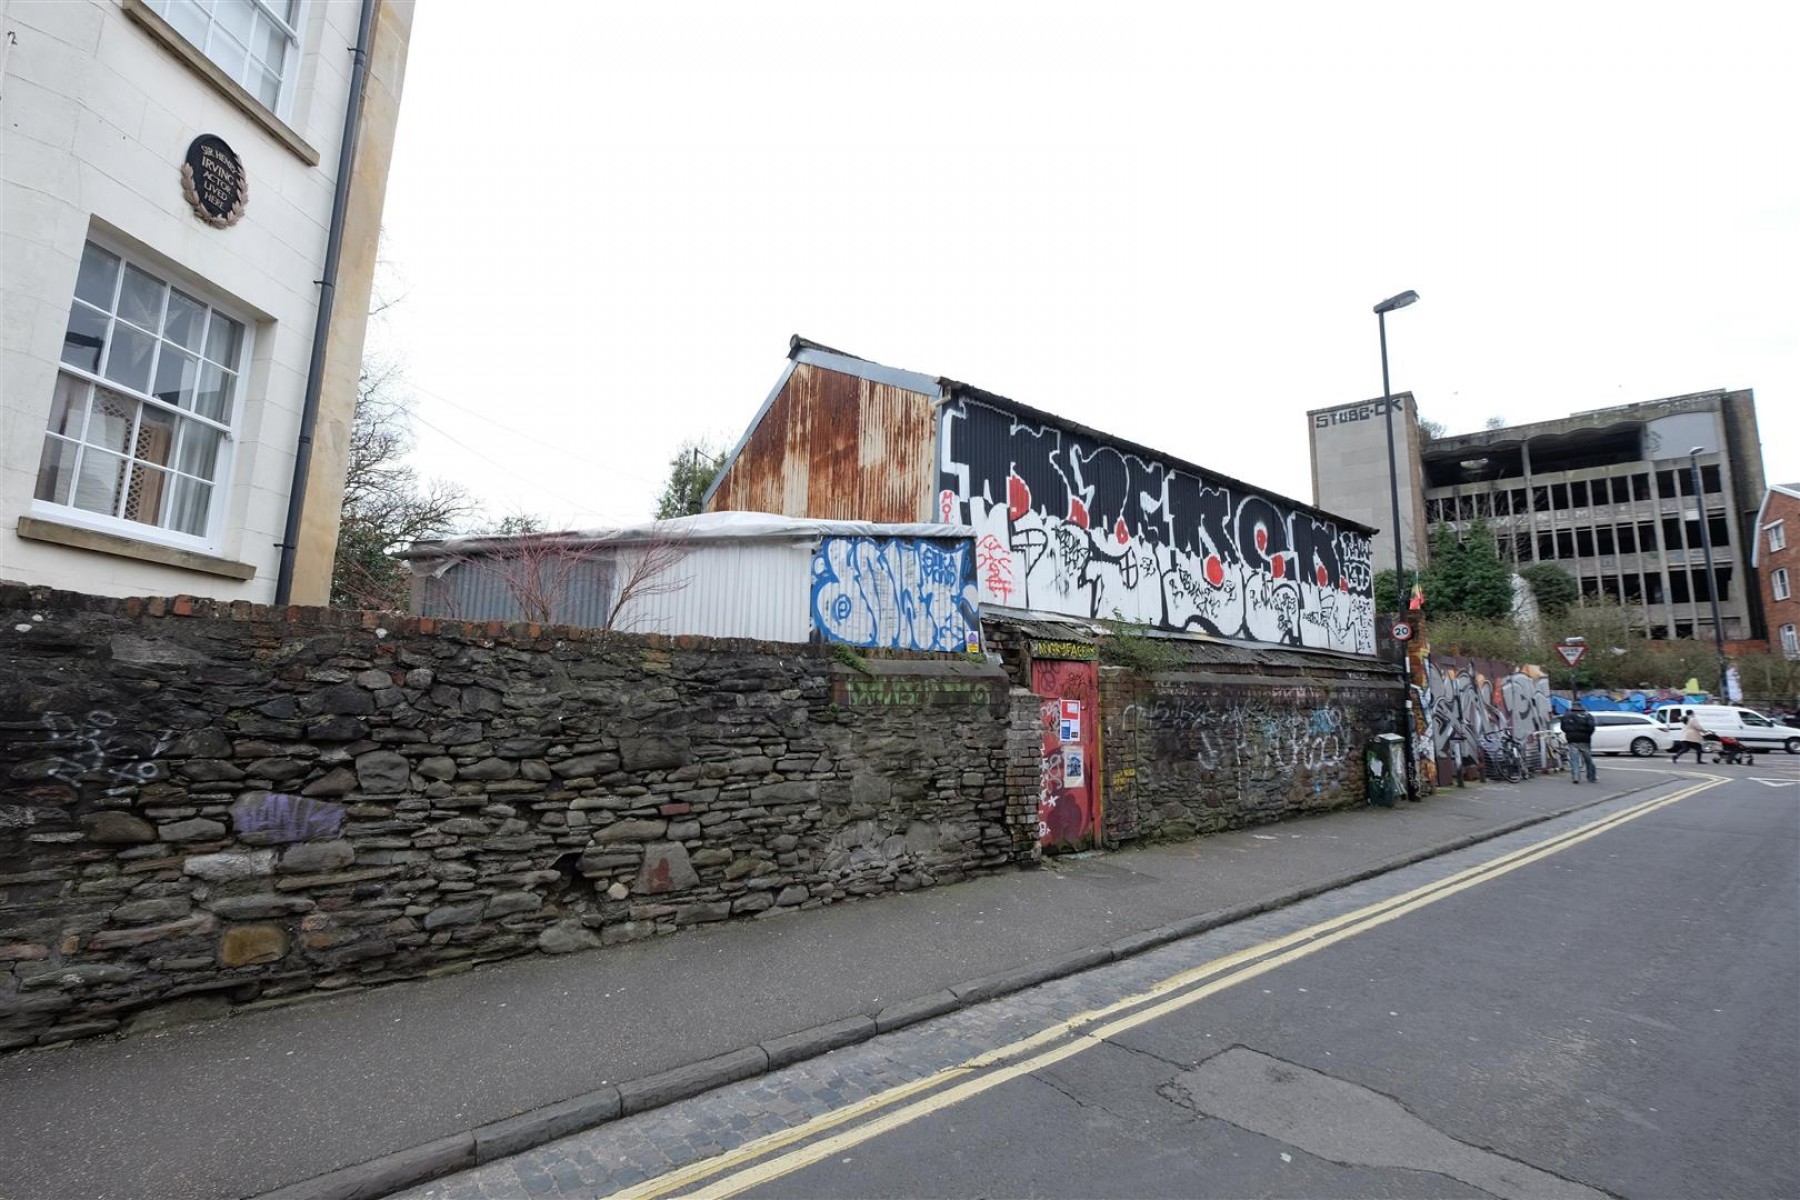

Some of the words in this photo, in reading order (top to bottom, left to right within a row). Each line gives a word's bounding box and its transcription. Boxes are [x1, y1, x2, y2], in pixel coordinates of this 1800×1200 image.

[201, 145, 214, 157] SIR
[215, 150, 238, 173] HENRY
[201, 156, 234, 185] IRVING
[203, 171, 231, 194] ACTOR
[203, 180, 228, 201] LIVED
[204, 192, 225, 211] HERE
[1394, 627, 1409, 636] 20
